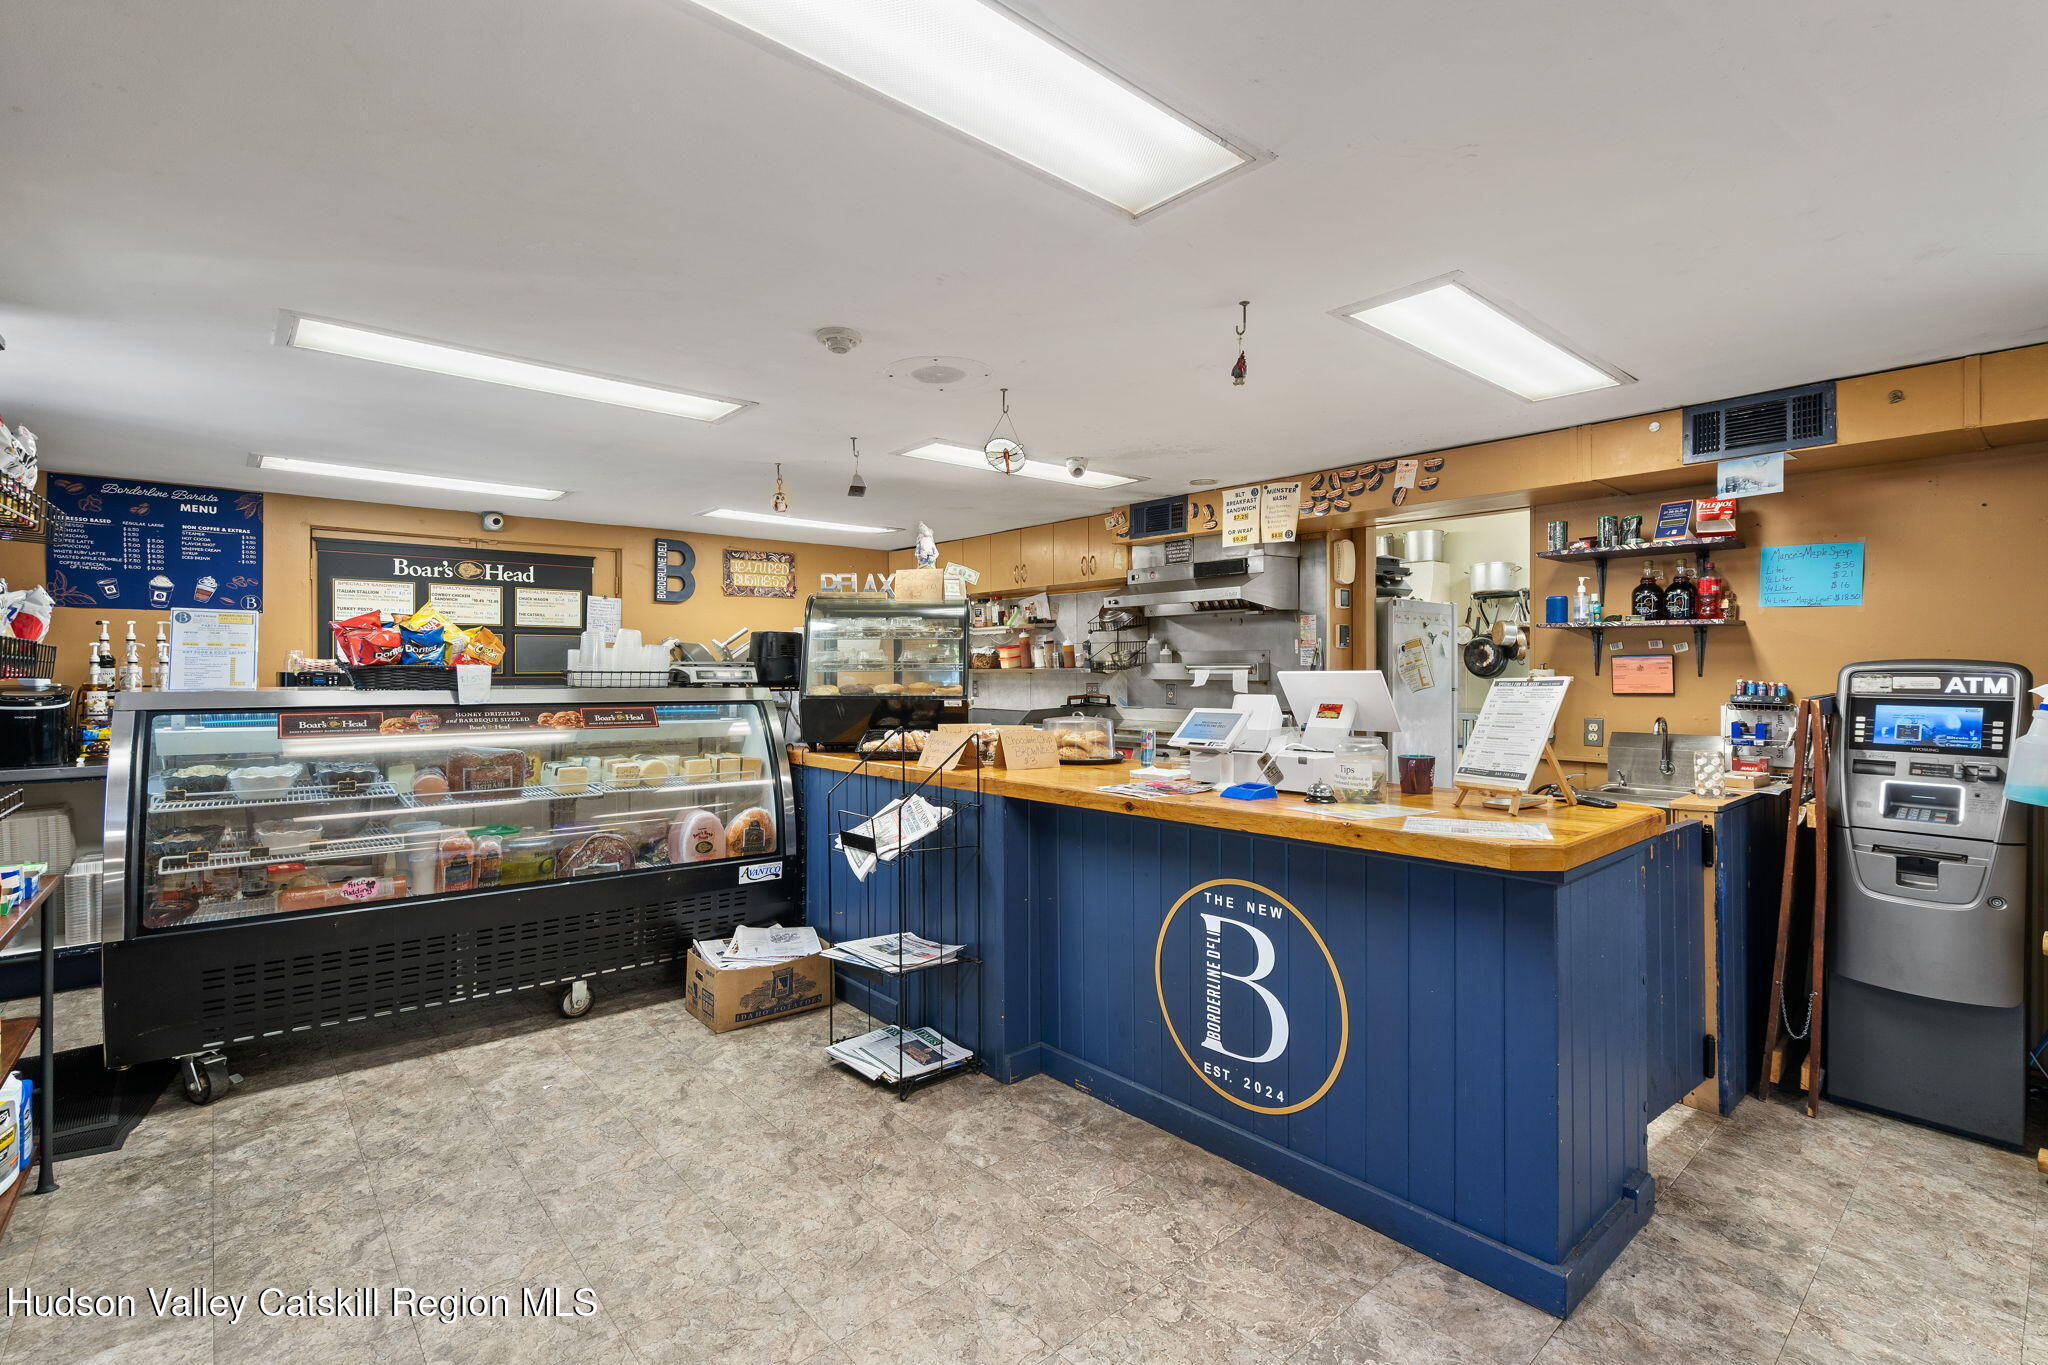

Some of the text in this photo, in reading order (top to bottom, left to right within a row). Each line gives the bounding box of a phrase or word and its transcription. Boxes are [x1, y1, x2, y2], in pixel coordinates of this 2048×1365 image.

[101, 483, 219, 502] Borderline Barista
[180, 503, 217, 514] MENU
[1226, 498, 1257, 506] BREAKFAST
[1698, 501, 1733, 511] TYLENOL
[1227, 505, 1256, 513] SANDWICH
[1830, 546, 1852, 559] Syrup
[393, 558, 535, 583] Boar's Head
[654, 538, 695, 603] B
[657, 542, 667, 598] BORDERLINE DELI
[1766, 565, 1784, 575] Liter
[1775, 575, 1792, 583] Liter
[405, 644, 437, 654] Doritos
[1944, 676, 2008, 694] ATM
[299, 719, 367, 729] Boar's Head
[1340, 764, 1355, 775] Tips
[741, 866, 781, 880] AVANTCO
[342, 888, 373, 896] Pudding
[1204, 892, 1282, 919] THE NEW
[1200, 912, 1289, 1063] B
[1206, 930, 1221, 1042] BORDERLINE DELI
[736, 996, 821, 1022] IDAHO POTATOES
[1204, 1062, 1284, 1102] EST. 2024
